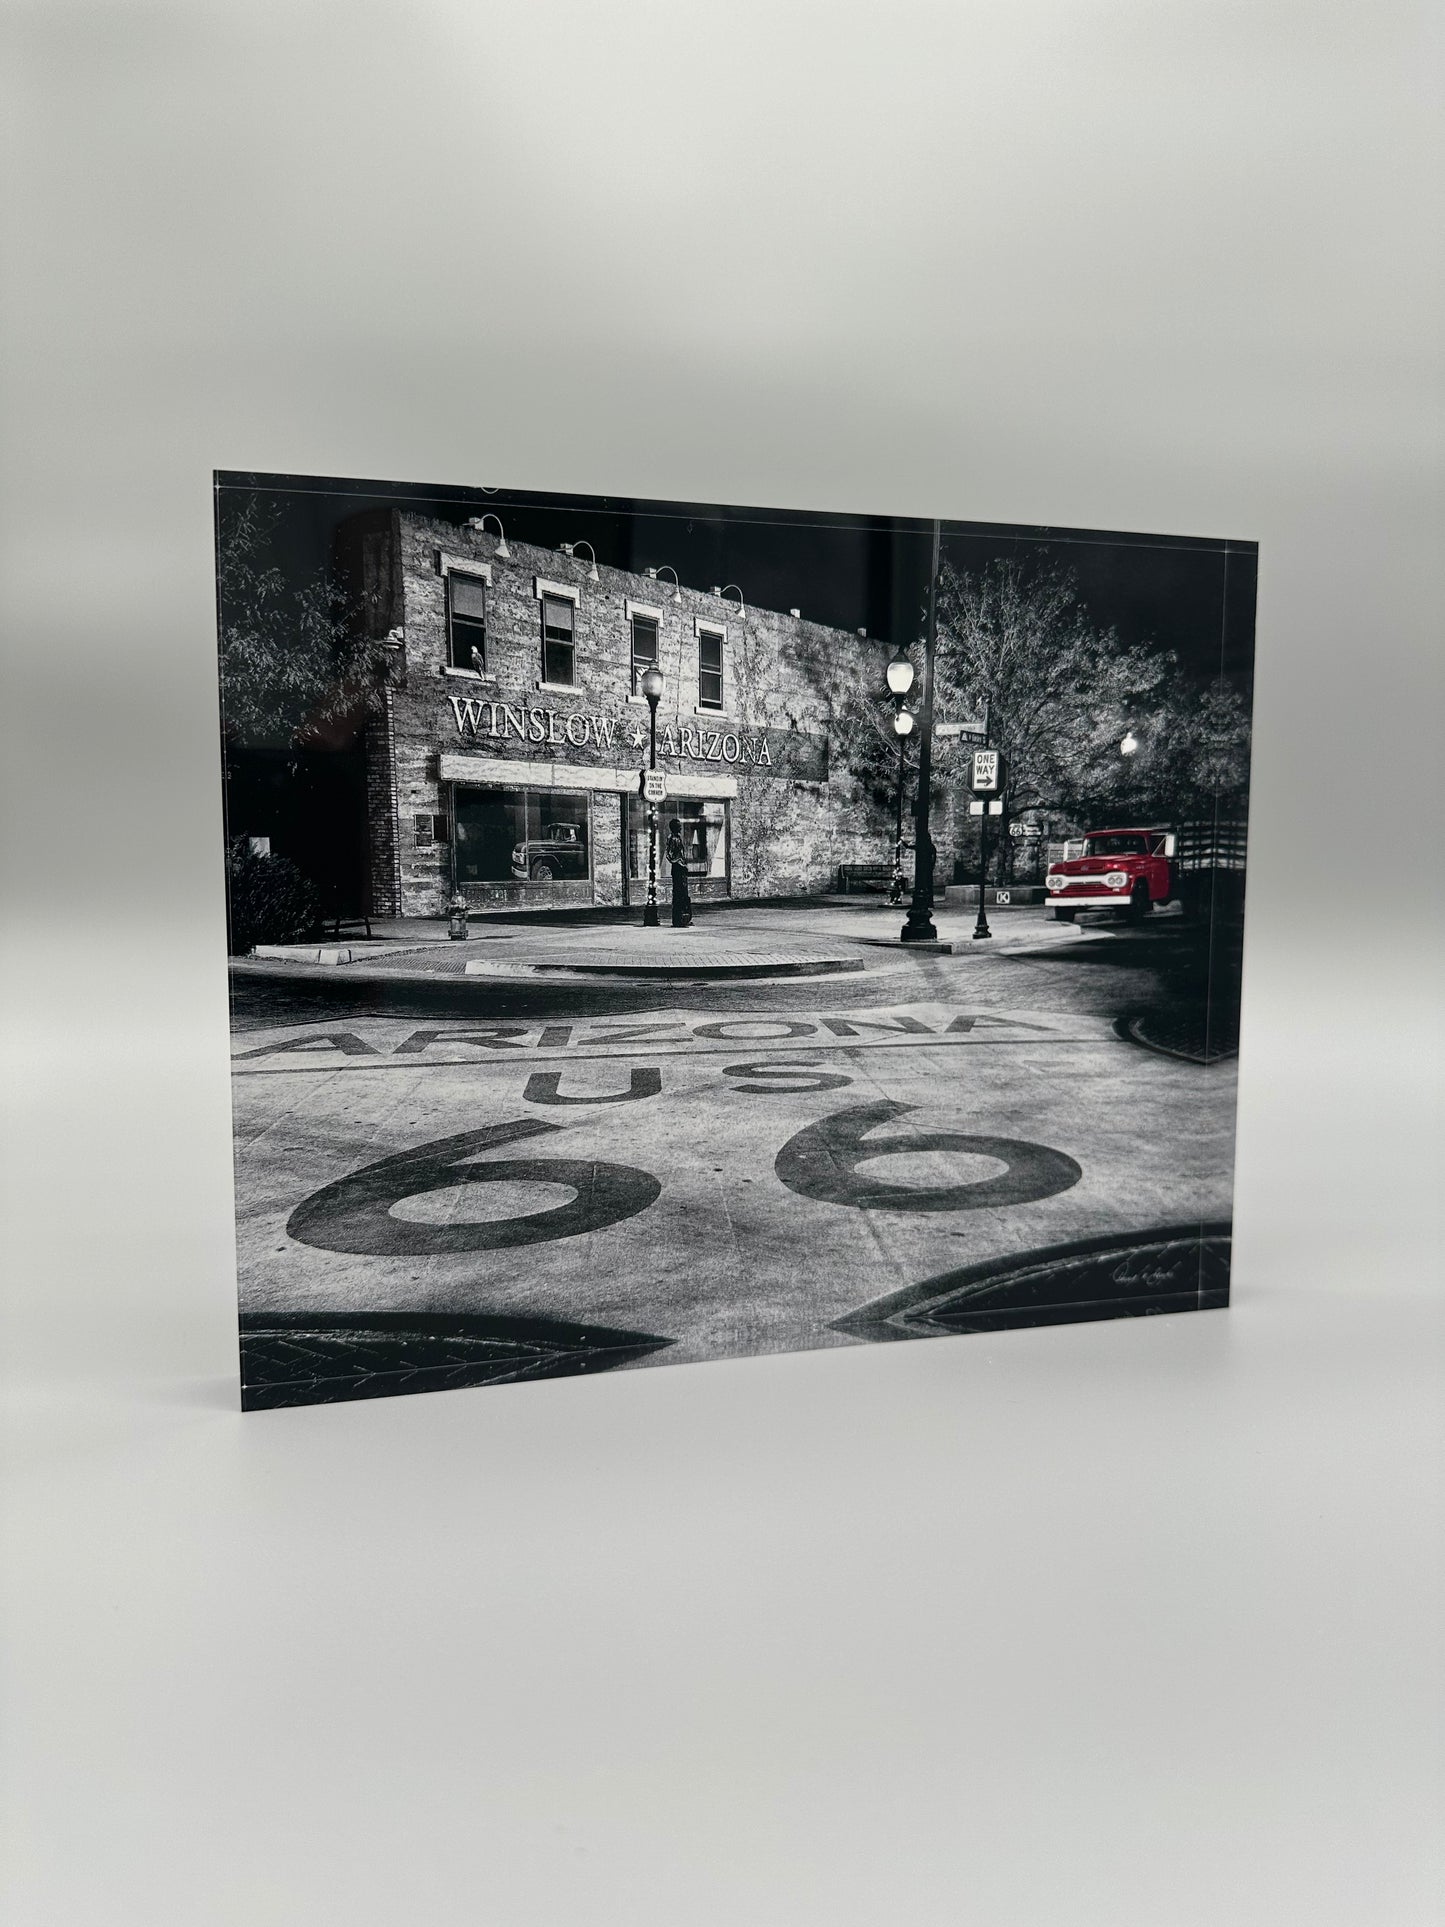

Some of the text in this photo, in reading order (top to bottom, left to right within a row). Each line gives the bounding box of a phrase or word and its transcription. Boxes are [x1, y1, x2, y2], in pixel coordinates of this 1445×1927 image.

[448, 695, 772, 766] WINSLOW ARIZONA
[977, 754, 995, 764] ONE
[976, 765, 995, 775] WAY
[1011, 825, 1021, 835] 66
[231, 1014, 1061, 1061] ARIZONA
